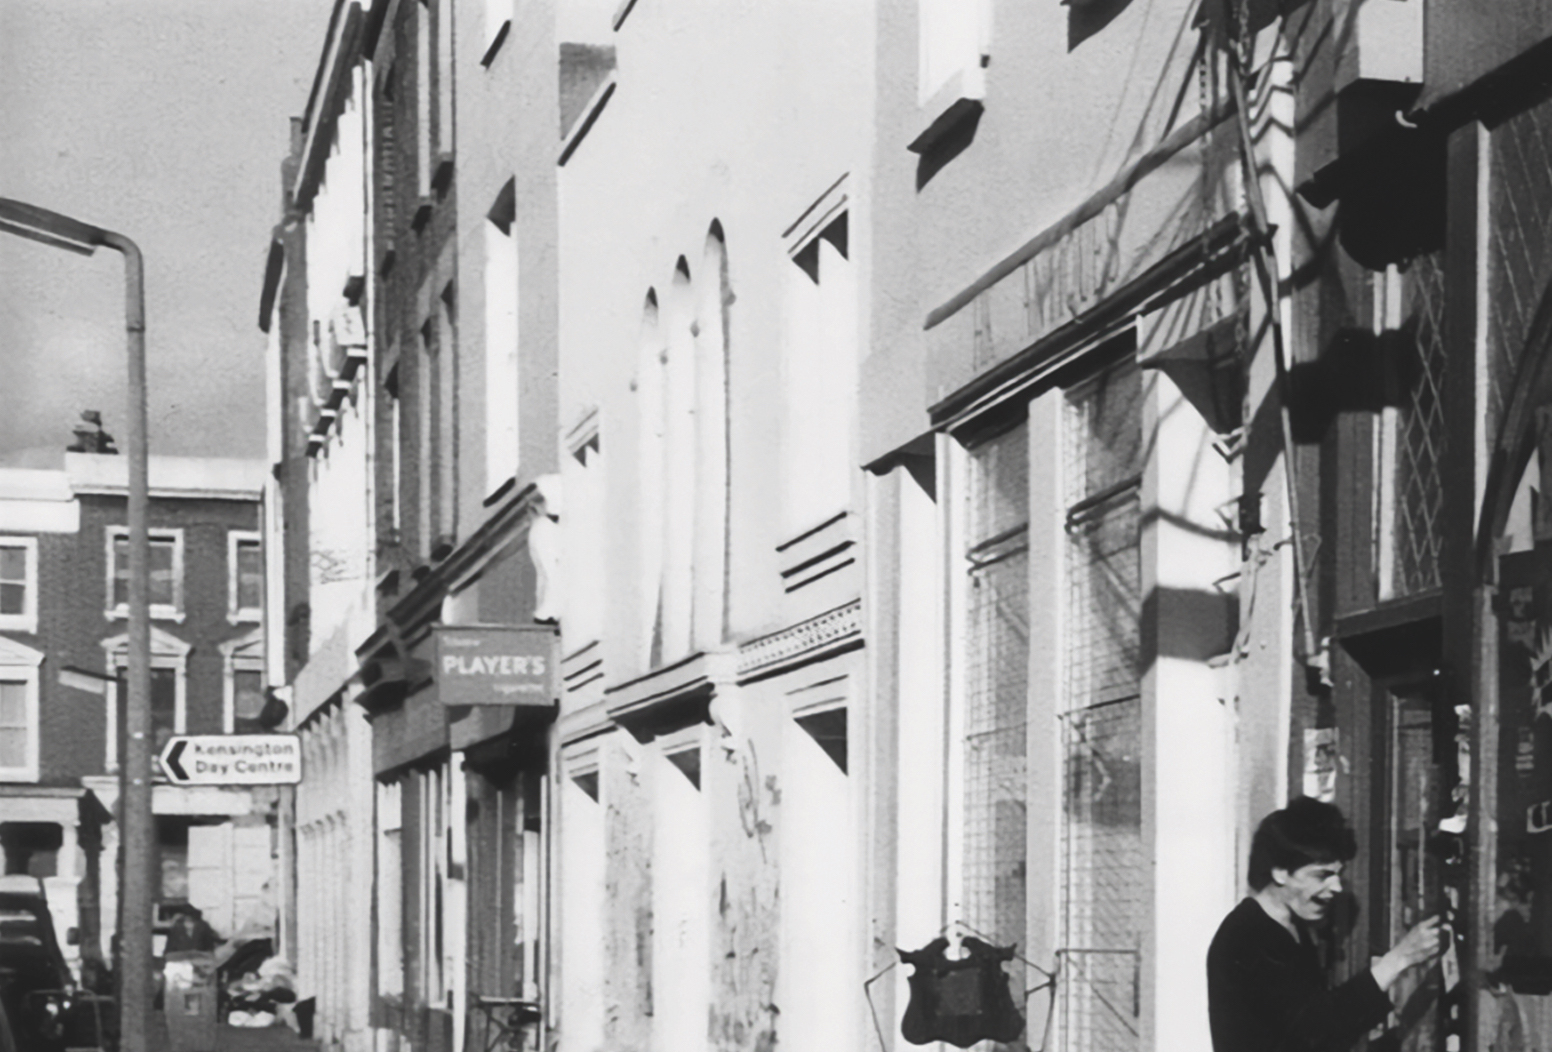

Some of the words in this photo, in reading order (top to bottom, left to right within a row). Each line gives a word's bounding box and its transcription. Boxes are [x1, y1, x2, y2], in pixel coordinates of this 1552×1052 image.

[442, 655, 546, 676] PLAYER'S
[194, 743, 294, 757] Kensington
[195, 760, 229, 775] Day
[234, 759, 294, 774] Centre
